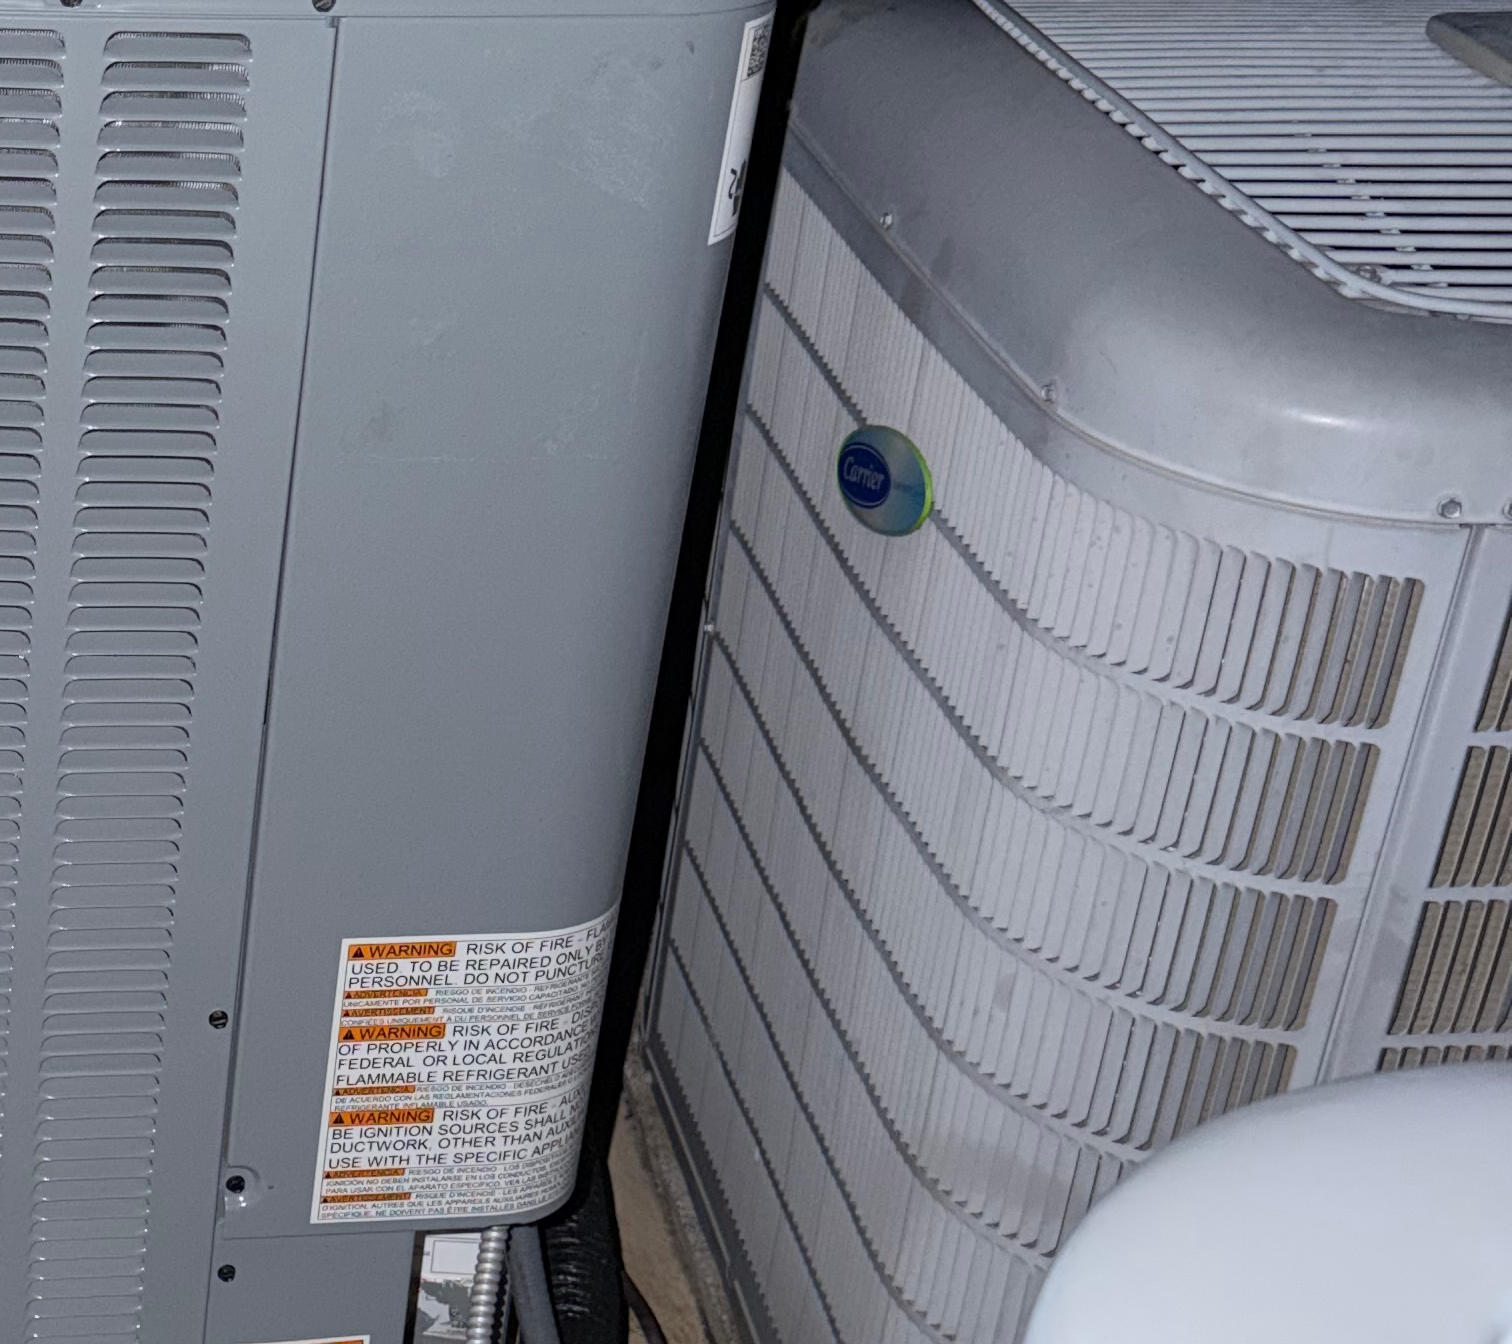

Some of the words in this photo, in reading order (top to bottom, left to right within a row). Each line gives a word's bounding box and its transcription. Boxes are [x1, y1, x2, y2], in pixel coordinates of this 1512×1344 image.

[843, 456, 885, 491] Carrier
[369, 943, 453, 957] WARNING
[466, 943, 506, 955] RISK
[511, 942, 534, 954] OF
[539, 936, 574, 952] FIRE
[410, 961, 432, 972] TO
[438, 960, 459, 972] BE
[465, 956, 551, 970] REPAIRED
[556, 944, 594, 965] ONLY
[464, 973, 488, 984] DO
[494, 972, 530, 984] NOT
[338, 1044, 362, 1055] OF
[367, 1040, 459, 1055] PROPERLY
[464, 1040, 479, 1051] IN
[484, 1023, 587, 1051] ACCORDANCE
[360, 1025, 442, 1039] WARNING
[453, 1025, 491, 1036] RISK
[497, 1024, 520, 1035] OF
[525, 1018, 559, 1034] FIRE
[338, 1057, 415, 1070] FEDERAL
[423, 1055, 447, 1067] OR
[453, 1053, 507, 1065] LOCAL
[336, 1071, 437, 1085] FLAMMABLE
[443, 1061, 558, 1081] REFRIGERANT
[350, 1110, 430, 1125] WARNING
[443, 1109, 482, 1121] RISK
[486, 1108, 509, 1120] OF
[514, 1102, 548, 1118] FIRE
[332, 1129, 353, 1140] BE
[360, 1126, 433, 1139] IGNITION
[437, 1121, 519, 1135] SOURCES
[523, 1110, 567, 1131] SHALL
[438, 1136, 496, 1148] OTHER
[502, 1132, 543, 1146] THAN
[329, 1157, 361, 1169] USE
[368, 1156, 410, 1167] WITH
[416, 1154, 448, 1165] THE
[452, 1149, 528, 1164] SPECIFIC
